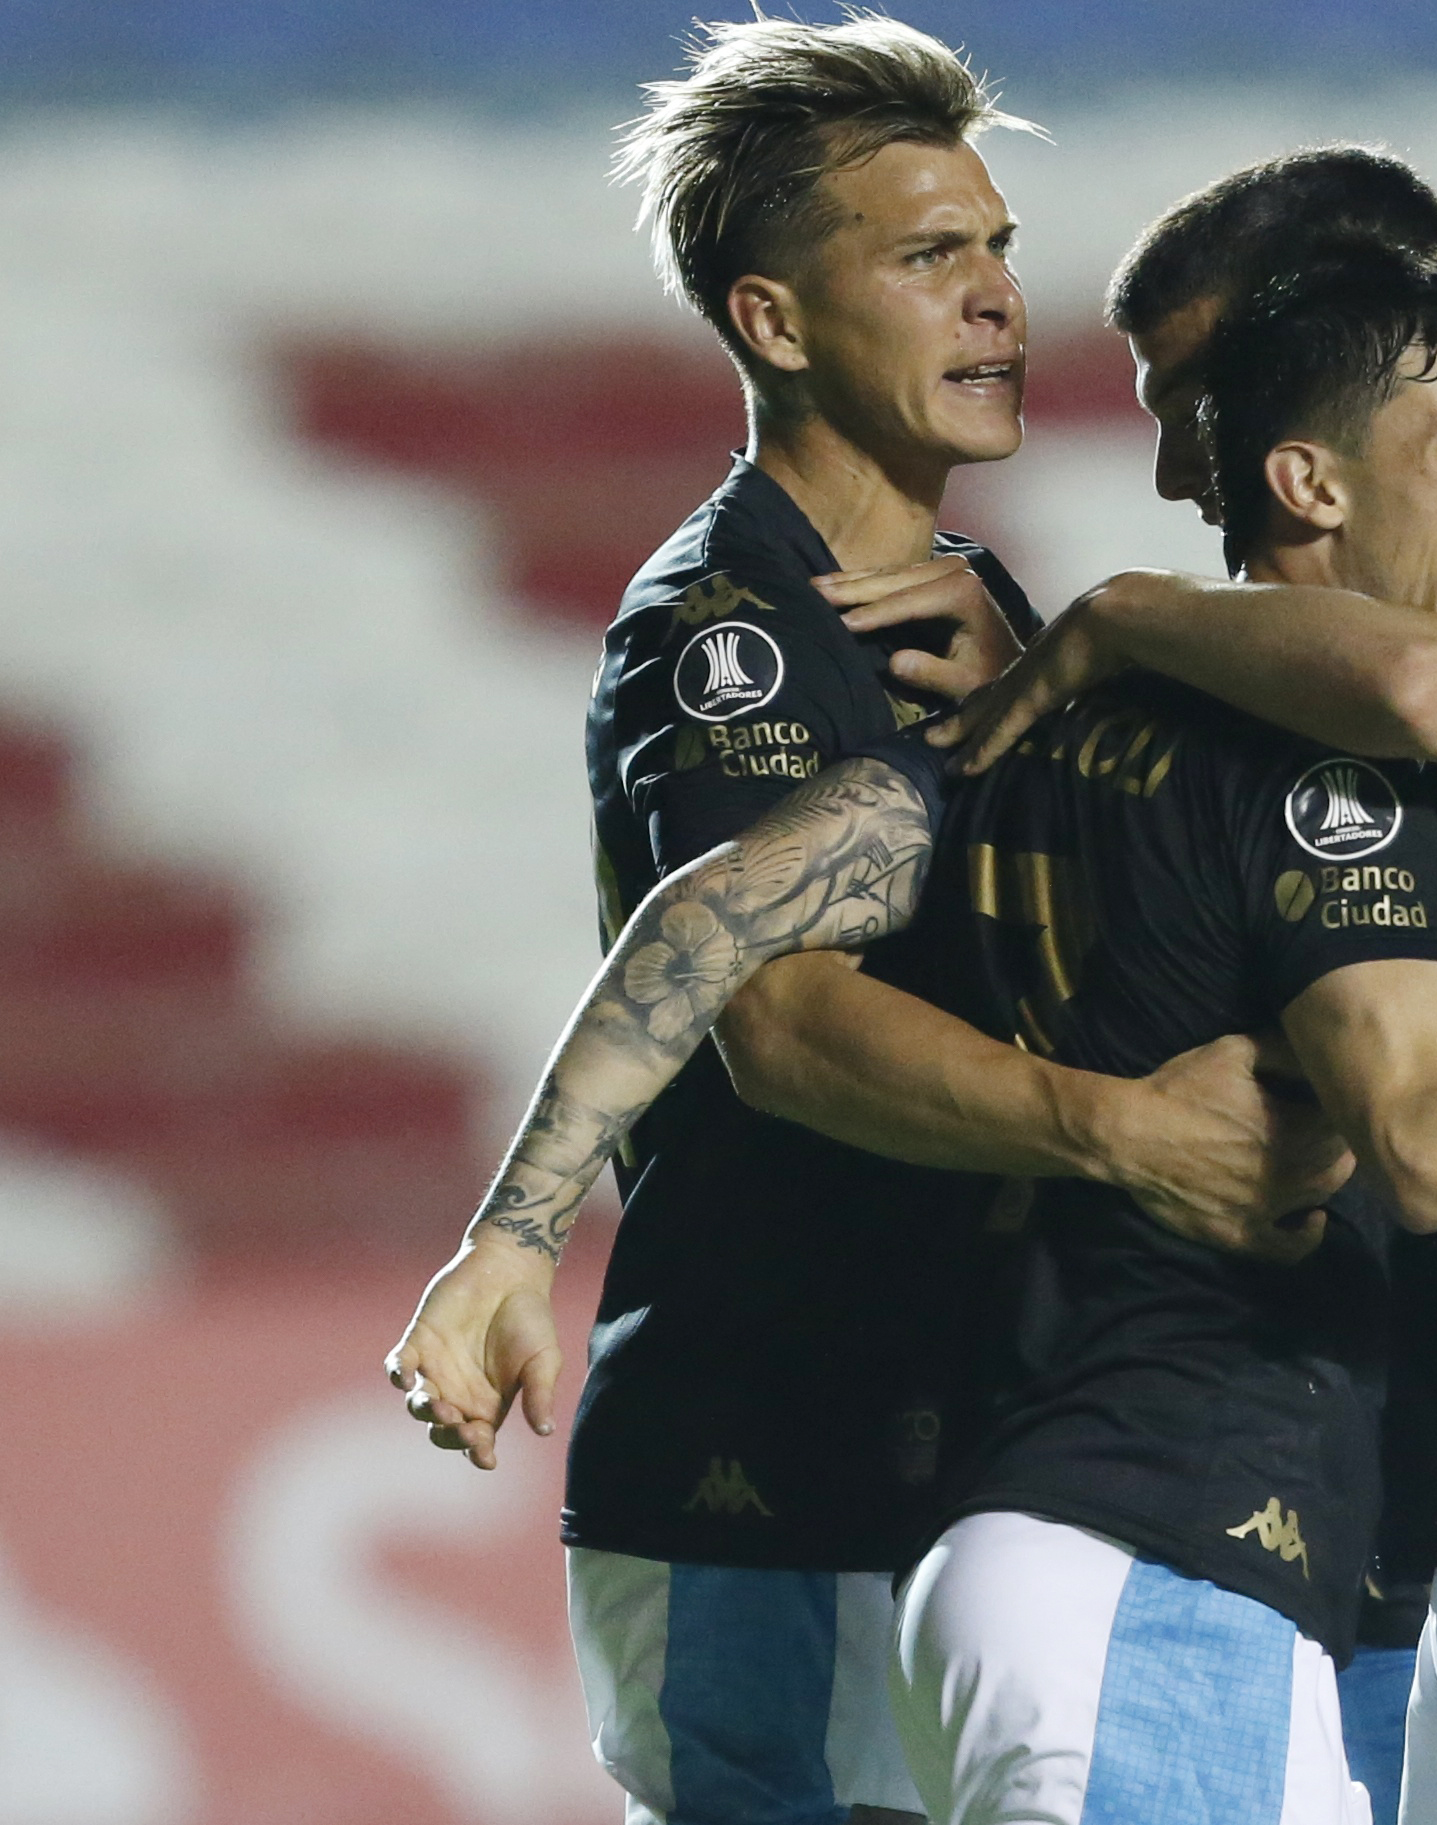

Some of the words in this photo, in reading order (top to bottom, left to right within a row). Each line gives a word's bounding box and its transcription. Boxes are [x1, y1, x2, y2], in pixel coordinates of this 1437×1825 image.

[699, 689, 763, 712] LIBERTADORES
[708, 721, 810, 750] Banco
[719, 745, 819, 779] Ciudad
[1314, 829, 1384, 847] LIBERTADORES
[1320, 866, 1415, 894] Banco
[1320, 895, 1428, 929] Ciudad
